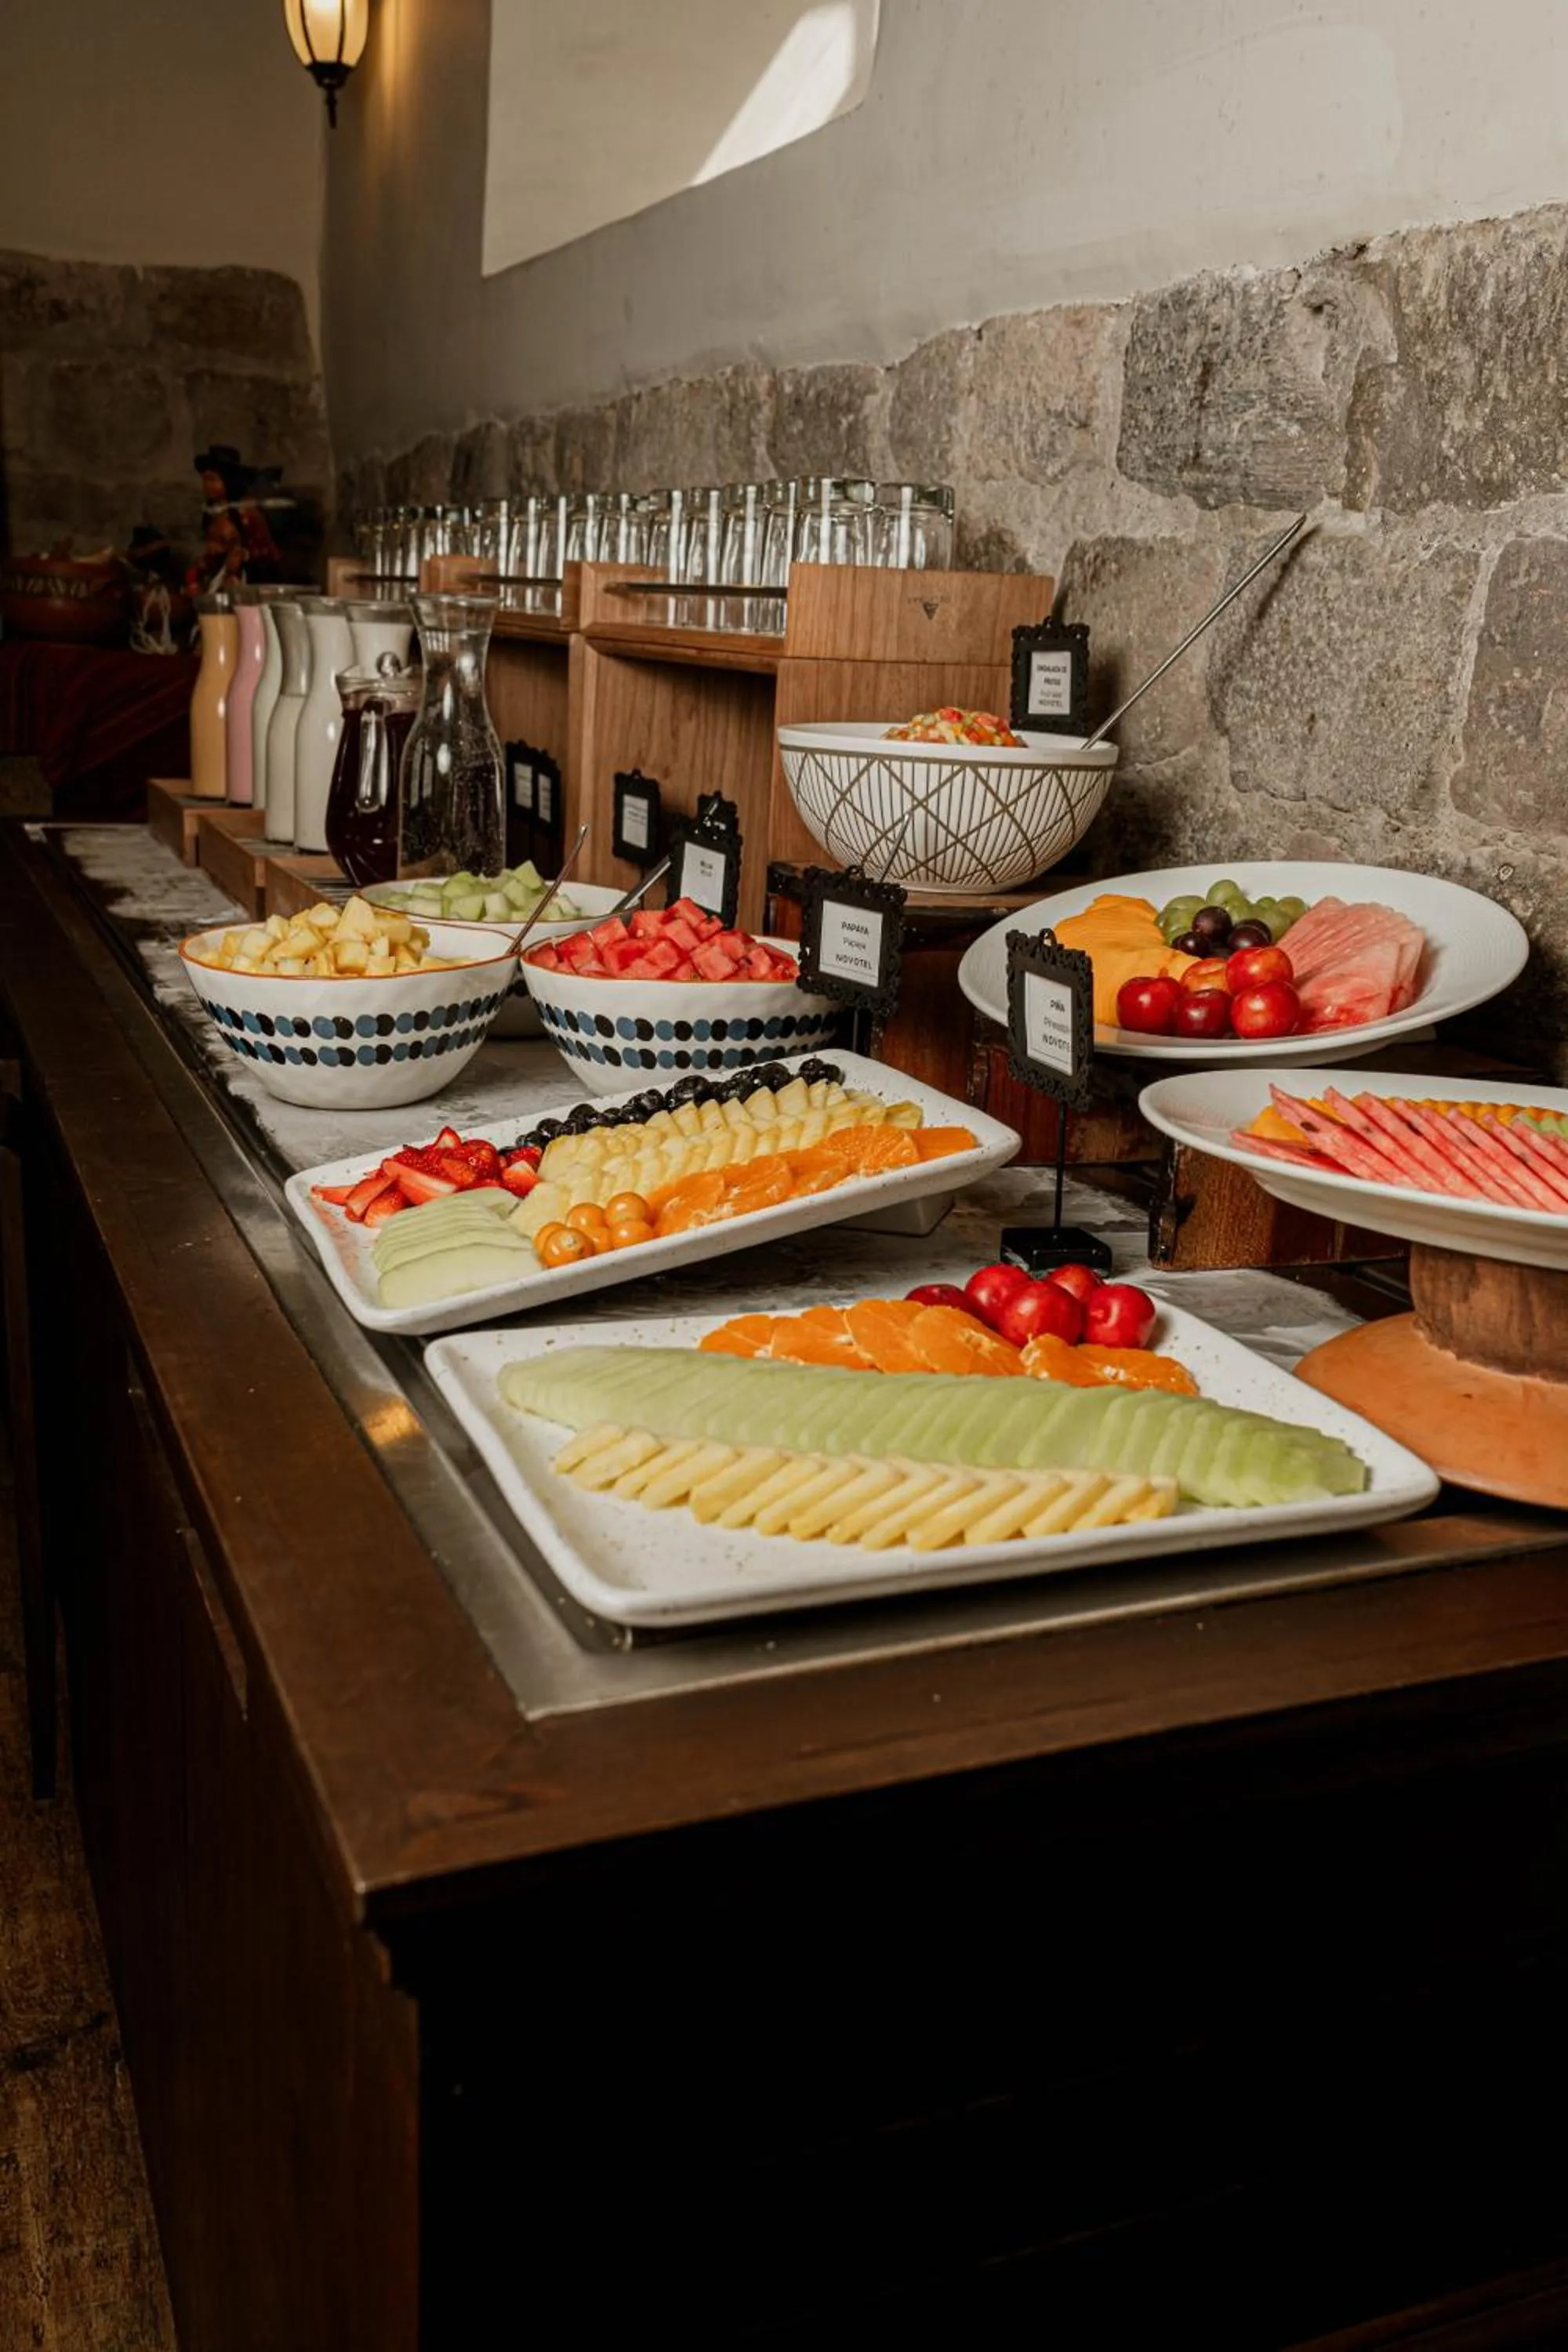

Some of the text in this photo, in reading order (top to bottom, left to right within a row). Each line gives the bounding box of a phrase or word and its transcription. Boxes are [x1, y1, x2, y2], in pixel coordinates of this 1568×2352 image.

[841, 921, 869, 935] PAPAYA
[836, 953, 872, 970] NOVOTEL
[1043, 1035, 1070, 1052] NOVOTE
